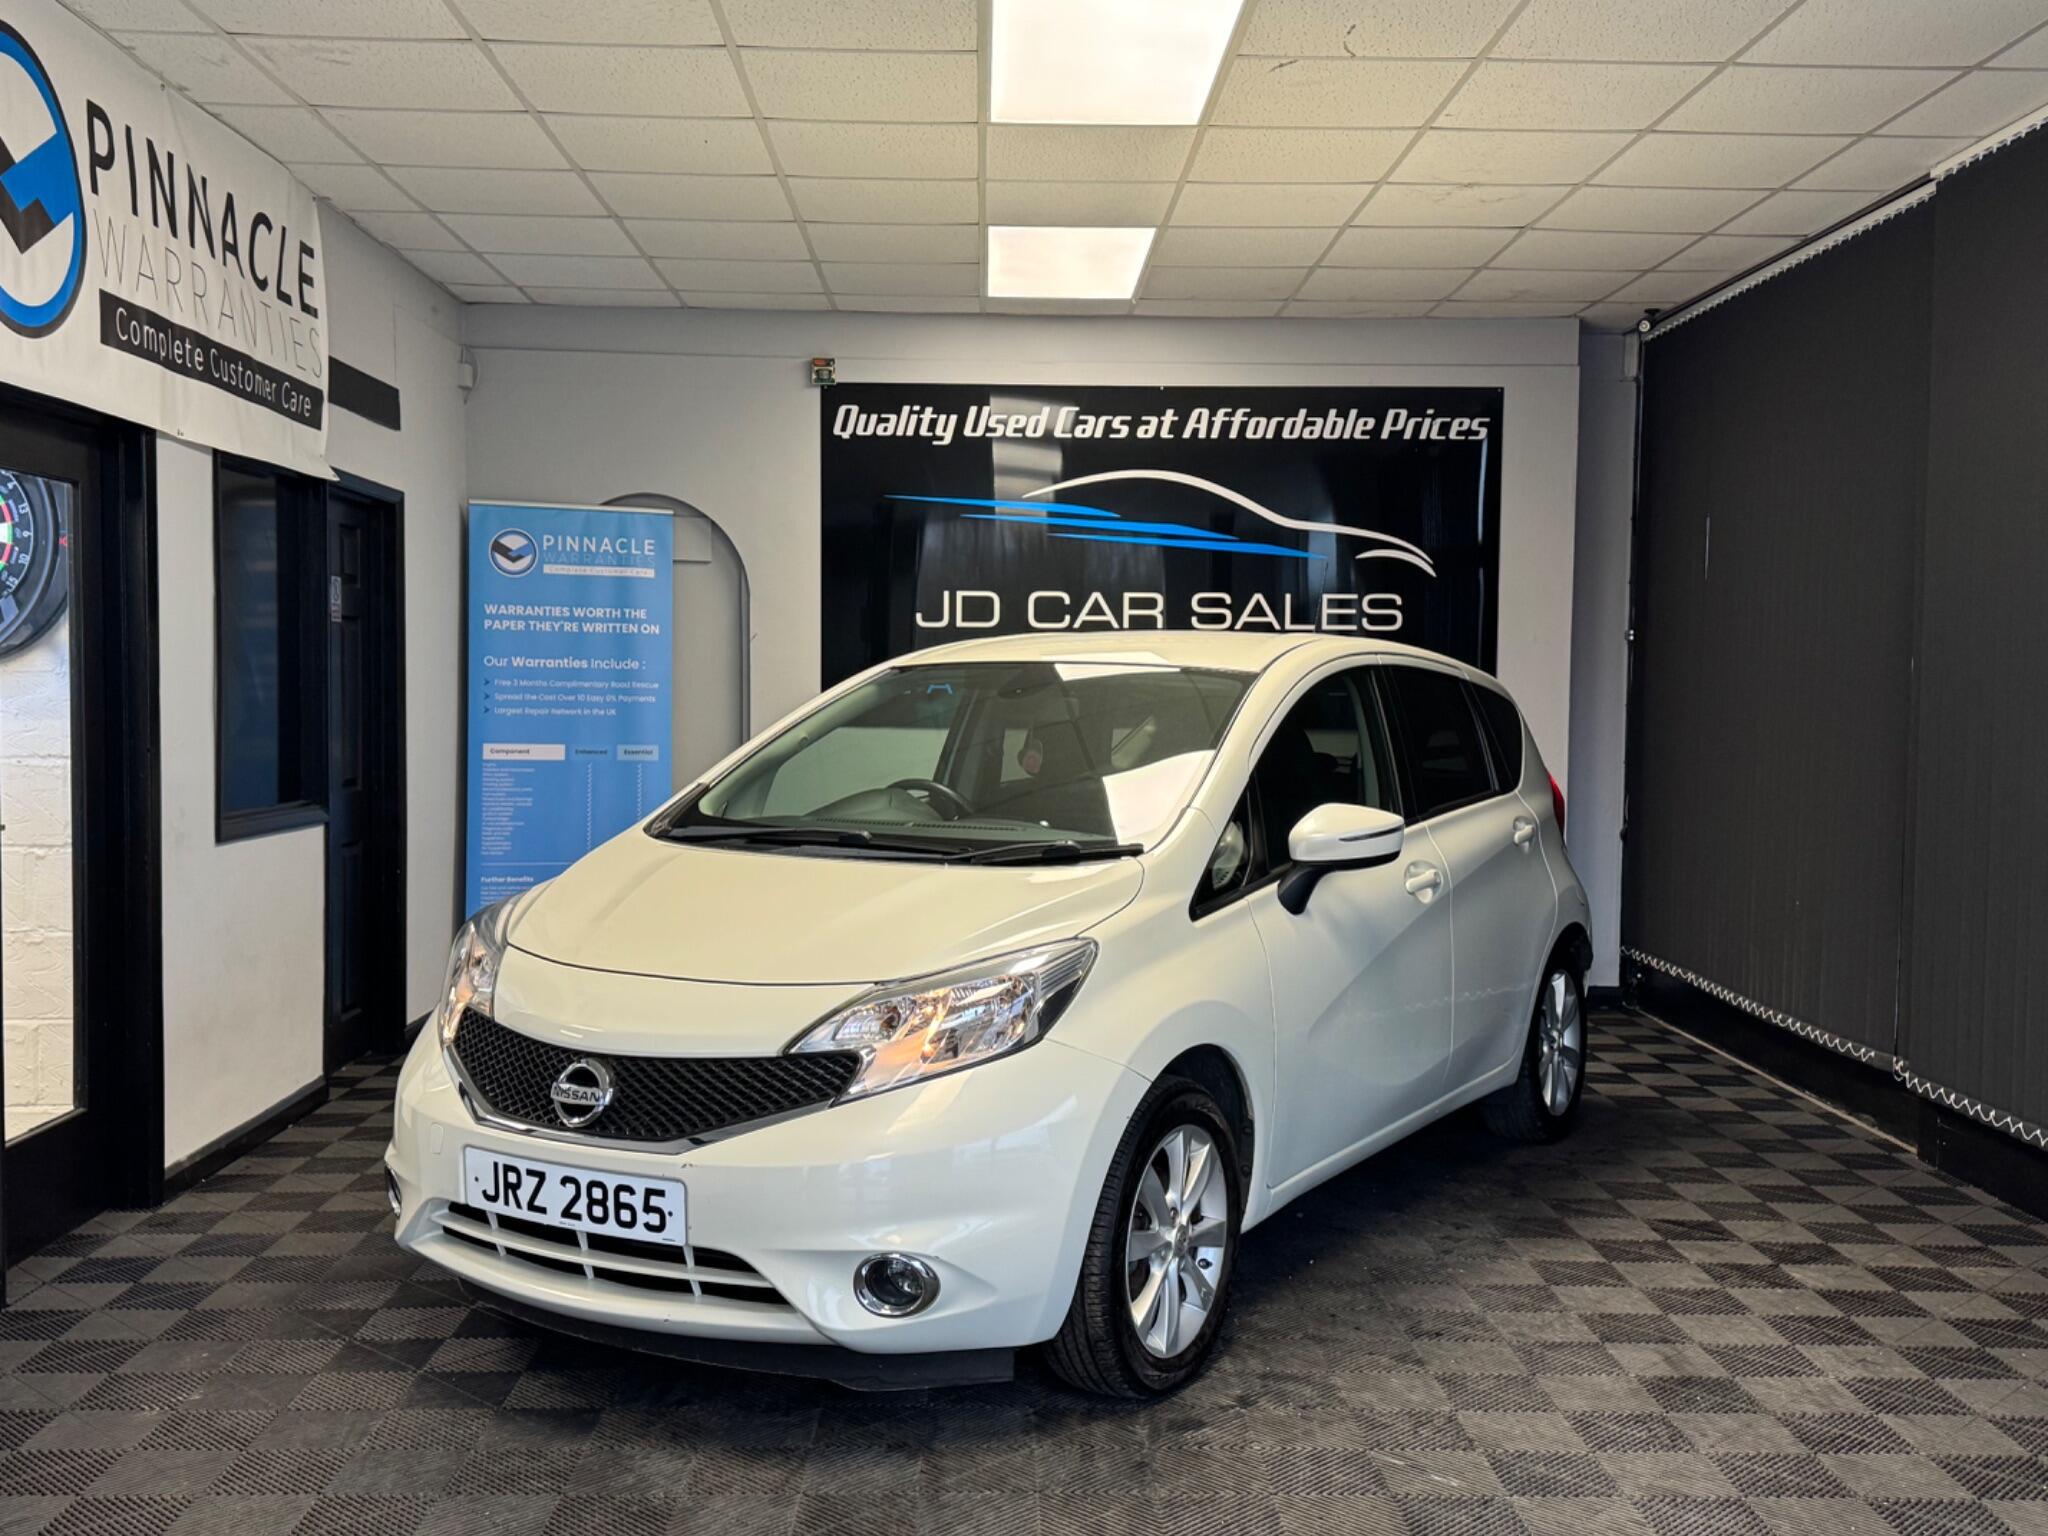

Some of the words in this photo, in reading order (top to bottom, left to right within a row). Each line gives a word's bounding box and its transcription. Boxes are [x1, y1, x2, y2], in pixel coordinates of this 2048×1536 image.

[87, 98, 320, 320] PINNACLE
[93, 208, 323, 379] WARRANTIES
[115, 307, 204, 371] Complete
[210, 349, 277, 403] Customer
[281, 382, 312, 417] Care
[832, 404, 958, 446] Quality
[963, 405, 1050, 438] Used
[1053, 406, 1132, 439] Cars
[1136, 408, 1179, 439] at
[1181, 408, 1375, 440] Affordable
[1380, 408, 1491, 440] Prices
[543, 534, 656, 556] PINNACLE
[544, 552, 656, 567] WARRANTIES
[484, 604, 570, 617] WARRANTIES
[573, 607, 620, 618] WORTH
[624, 608, 647, 619] THE
[915, 590, 1000, 628] JD
[1028, 592, 1164, 630] CAR
[1191, 592, 1404, 632] SALES
[484, 619, 525, 631] PAPER
[529, 620, 578, 632] THEY'RE
[582, 622, 638, 634] WRITTEN
[641, 624, 660, 635] ON
[484, 656, 508, 667] Our
[511, 656, 588, 669] Warranties
[591, 658, 640, 670] Include
[495, 679, 512, 687] Free
[513, 679, 518, 687] 3
[519, 680, 548, 688] Months
[549, 680, 609, 690] Complimentary
[495, 693, 522, 702] Spread
[524, 693, 537, 701] the
[618, 695, 657, 704] Payments
[495, 707, 522, 716] Largest
[524, 708, 550, 716] Repair
[592, 708, 605, 716] the
[554, 1086, 600, 1102] NISSAN
[482, 1161, 547, 1215] JRZ
[560, 1175, 667, 1234] 2865
